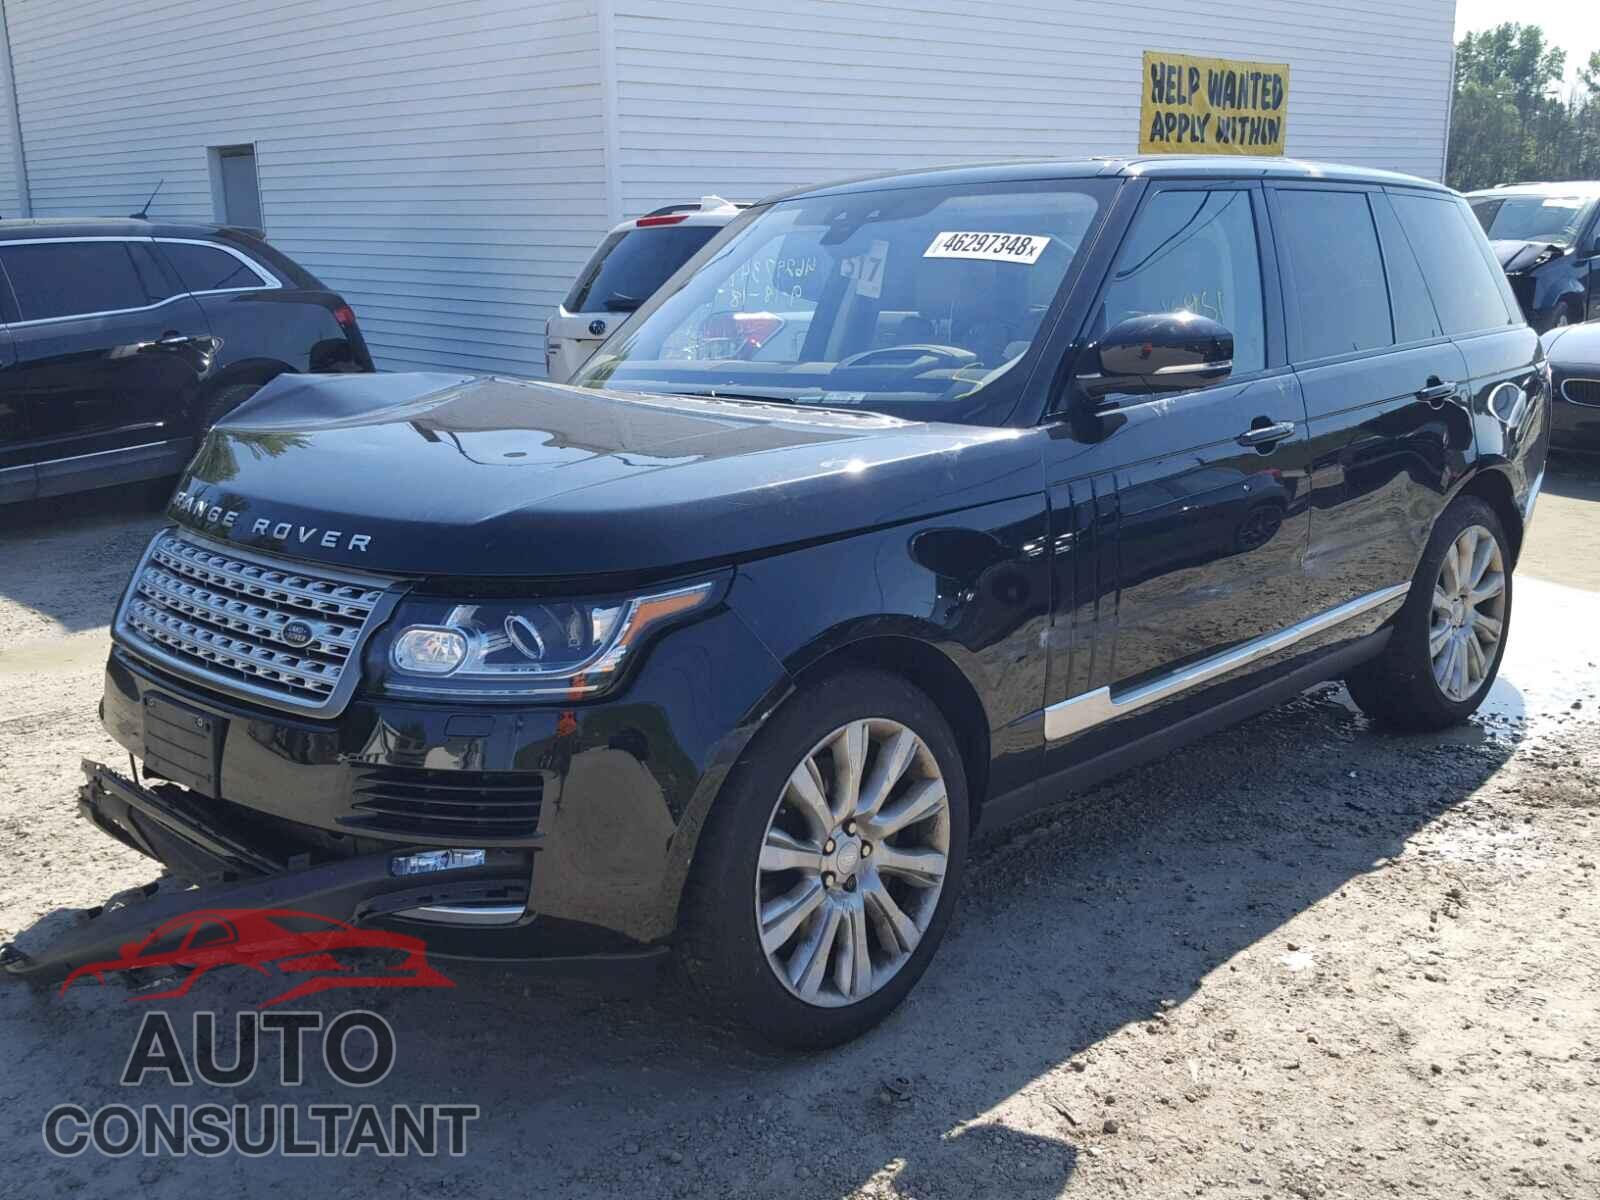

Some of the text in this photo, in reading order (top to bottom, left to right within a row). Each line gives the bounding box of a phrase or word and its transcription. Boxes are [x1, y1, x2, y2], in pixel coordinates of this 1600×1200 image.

[1151, 62, 1283, 111] HELP WANTED
[1150, 111, 1281, 145] APPLY WITHIN
[173, 491, 371, 551] RANGE ROVER
